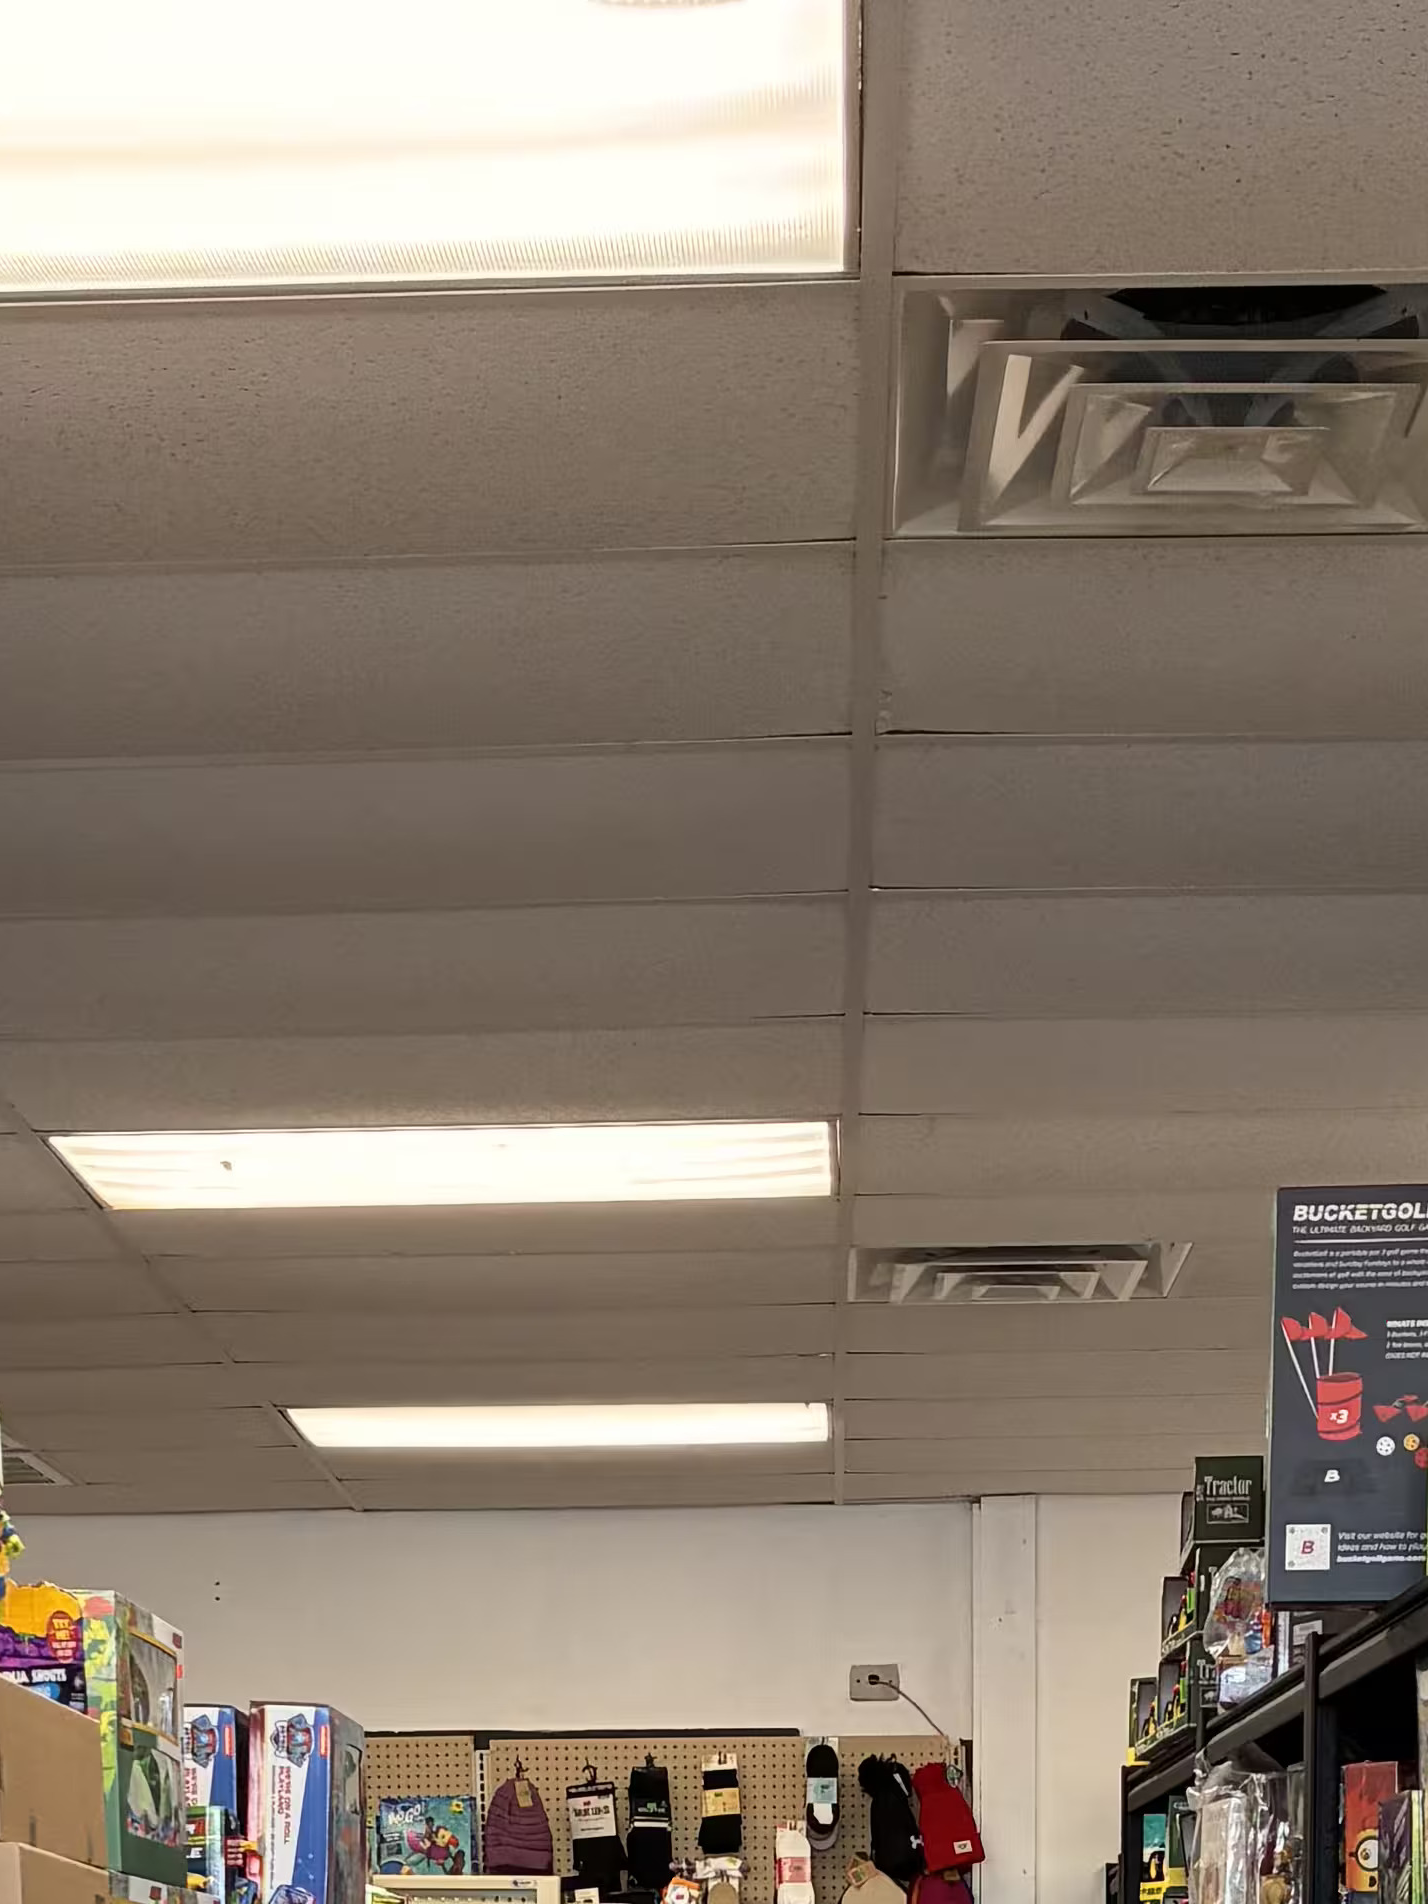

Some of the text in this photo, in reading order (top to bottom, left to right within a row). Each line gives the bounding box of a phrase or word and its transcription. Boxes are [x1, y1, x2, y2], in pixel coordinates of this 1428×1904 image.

[1395, 1223, 1415, 1232] GOLF
[1204, 1476, 1252, 1496] Tractor
[1338, 1532, 1355, 1540] Visit
[1373, 1531, 1405, 1540] website
[1406, 1531, 1418, 1540] for
[1301, 1541, 1314, 1554] B
